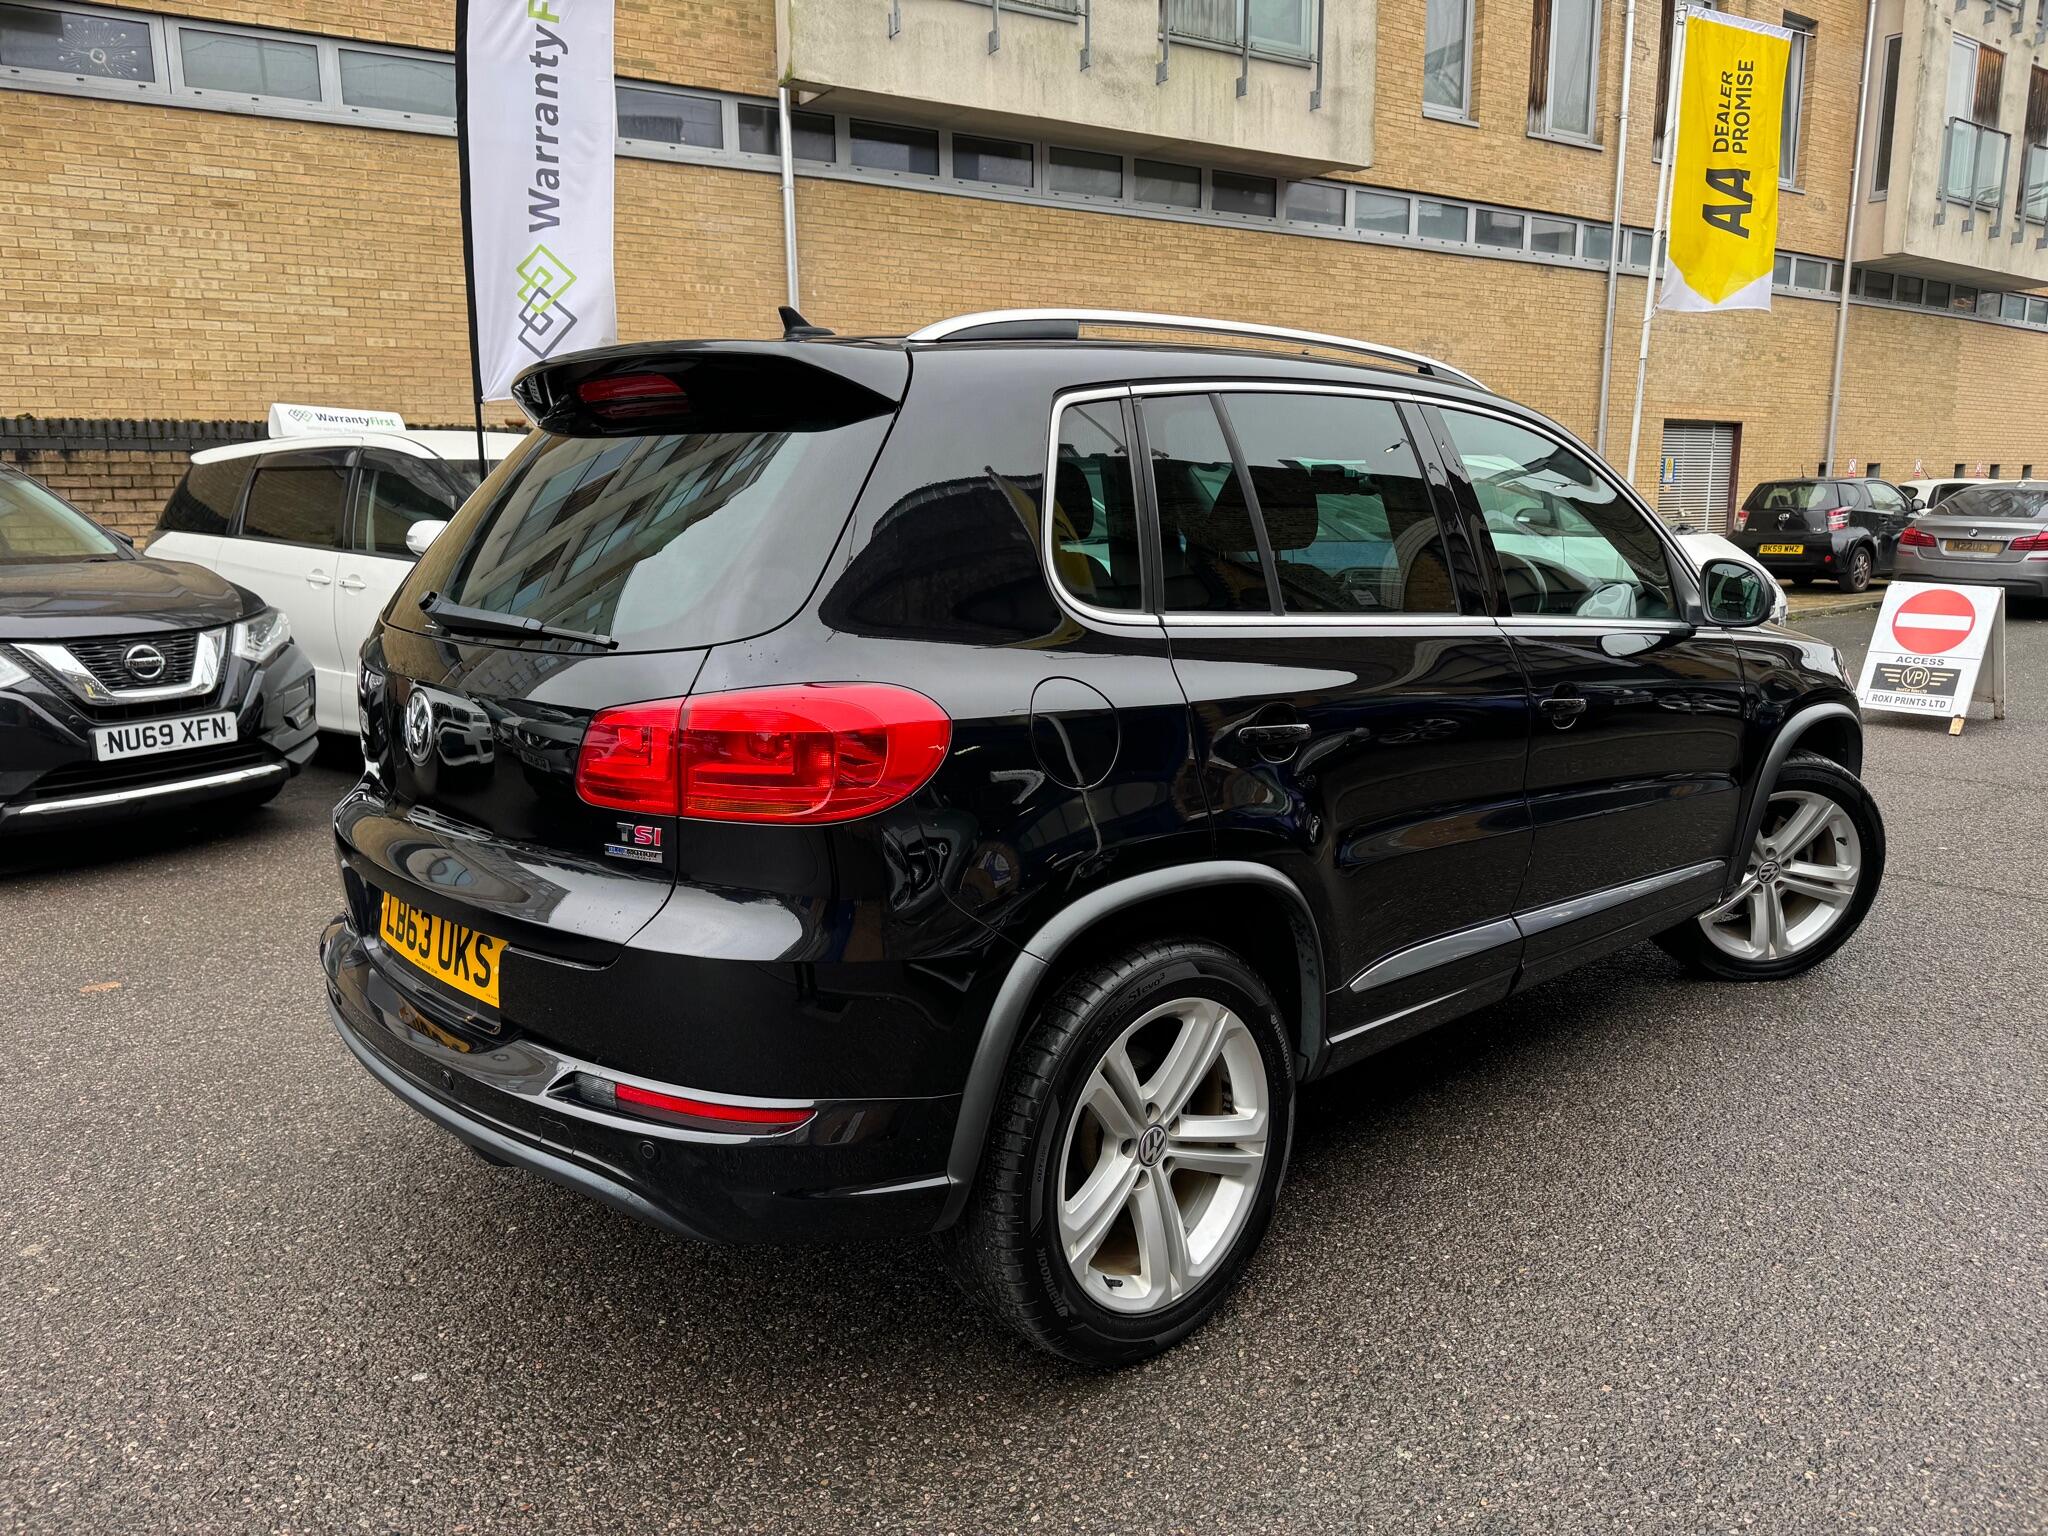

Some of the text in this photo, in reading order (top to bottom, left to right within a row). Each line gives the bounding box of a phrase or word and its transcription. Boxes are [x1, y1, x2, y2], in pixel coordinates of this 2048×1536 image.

[1713, 70, 1733, 153] DEALER
[1732, 60, 1754, 154] PROMISE
[1702, 168, 1753, 239] AA
[315, 412, 396, 427] WarrantyFirst
[1896, 656, 1945, 666] ACCESS
[1906, 670, 1927, 685] VPI
[1872, 694, 1946, 708] ROXI PRINTS LTD
[107, 716, 227, 754] NU69 XFN
[616, 822, 662, 846] TSI
[386, 892, 494, 988] LB63 UKS
